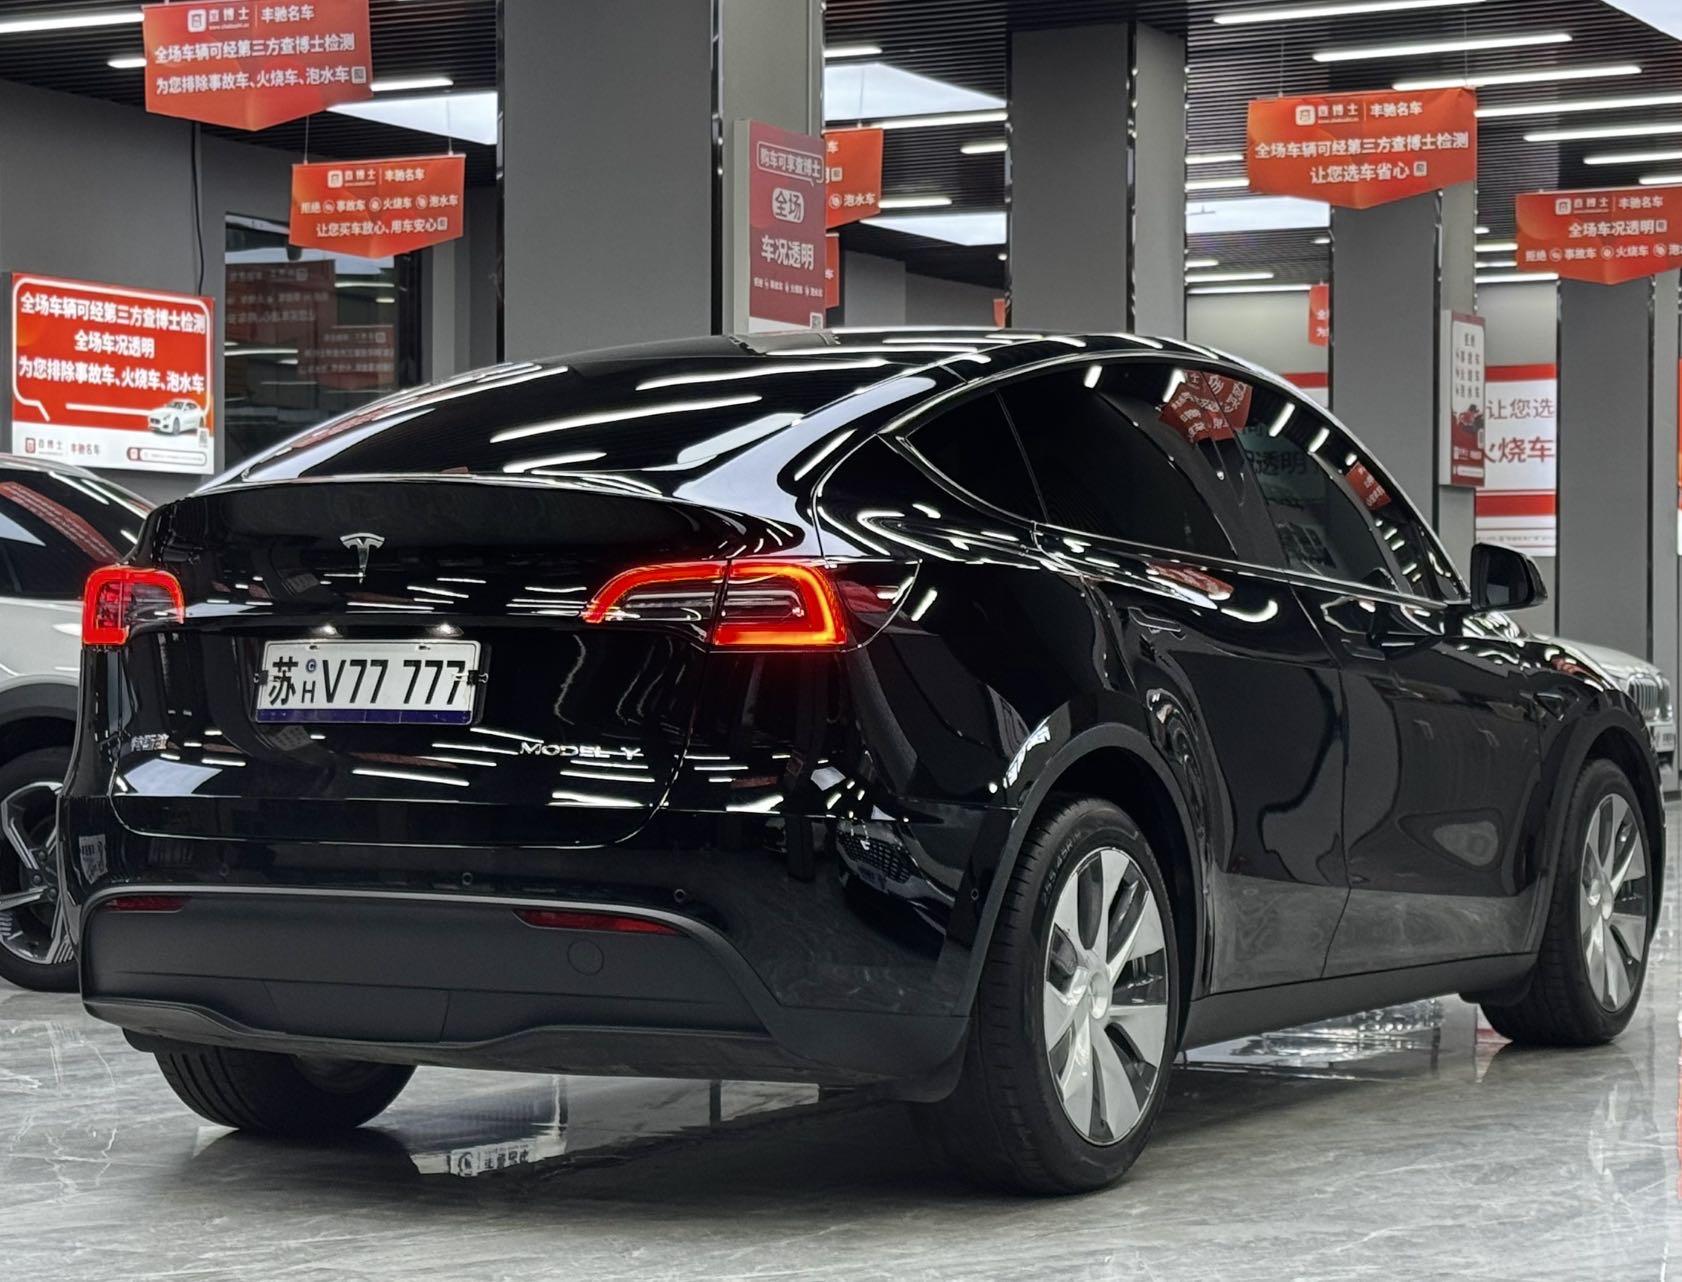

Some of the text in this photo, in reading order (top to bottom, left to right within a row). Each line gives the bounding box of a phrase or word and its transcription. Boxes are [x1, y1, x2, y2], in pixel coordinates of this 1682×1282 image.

[155, 33, 355, 64] 全场车辆可经第三方查博士检测
[156, 66, 350, 95] 为您排除事故车、火烧车、泡水车
[1255, 132, 1469, 159] 全场车辆可经第三方查博士检测
[760, 148, 821, 177] 购车可享查博士
[1310, 162, 1409, 184] 让您选车省心
[774, 191, 801, 220] 全场
[1568, 220, 1655, 238] 全场车况透明
[761, 234, 815, 271] 车况透明
[20, 291, 206, 334] 全场车辆可经第三方查博士检测
[74, 329, 155, 359] 全场车况透明
[18, 356, 205, 395] 为您排除事故车、火烧车、泡水车
[1486, 398, 1554, 420] 让您选
[519, 741, 610, 759] MODEL
